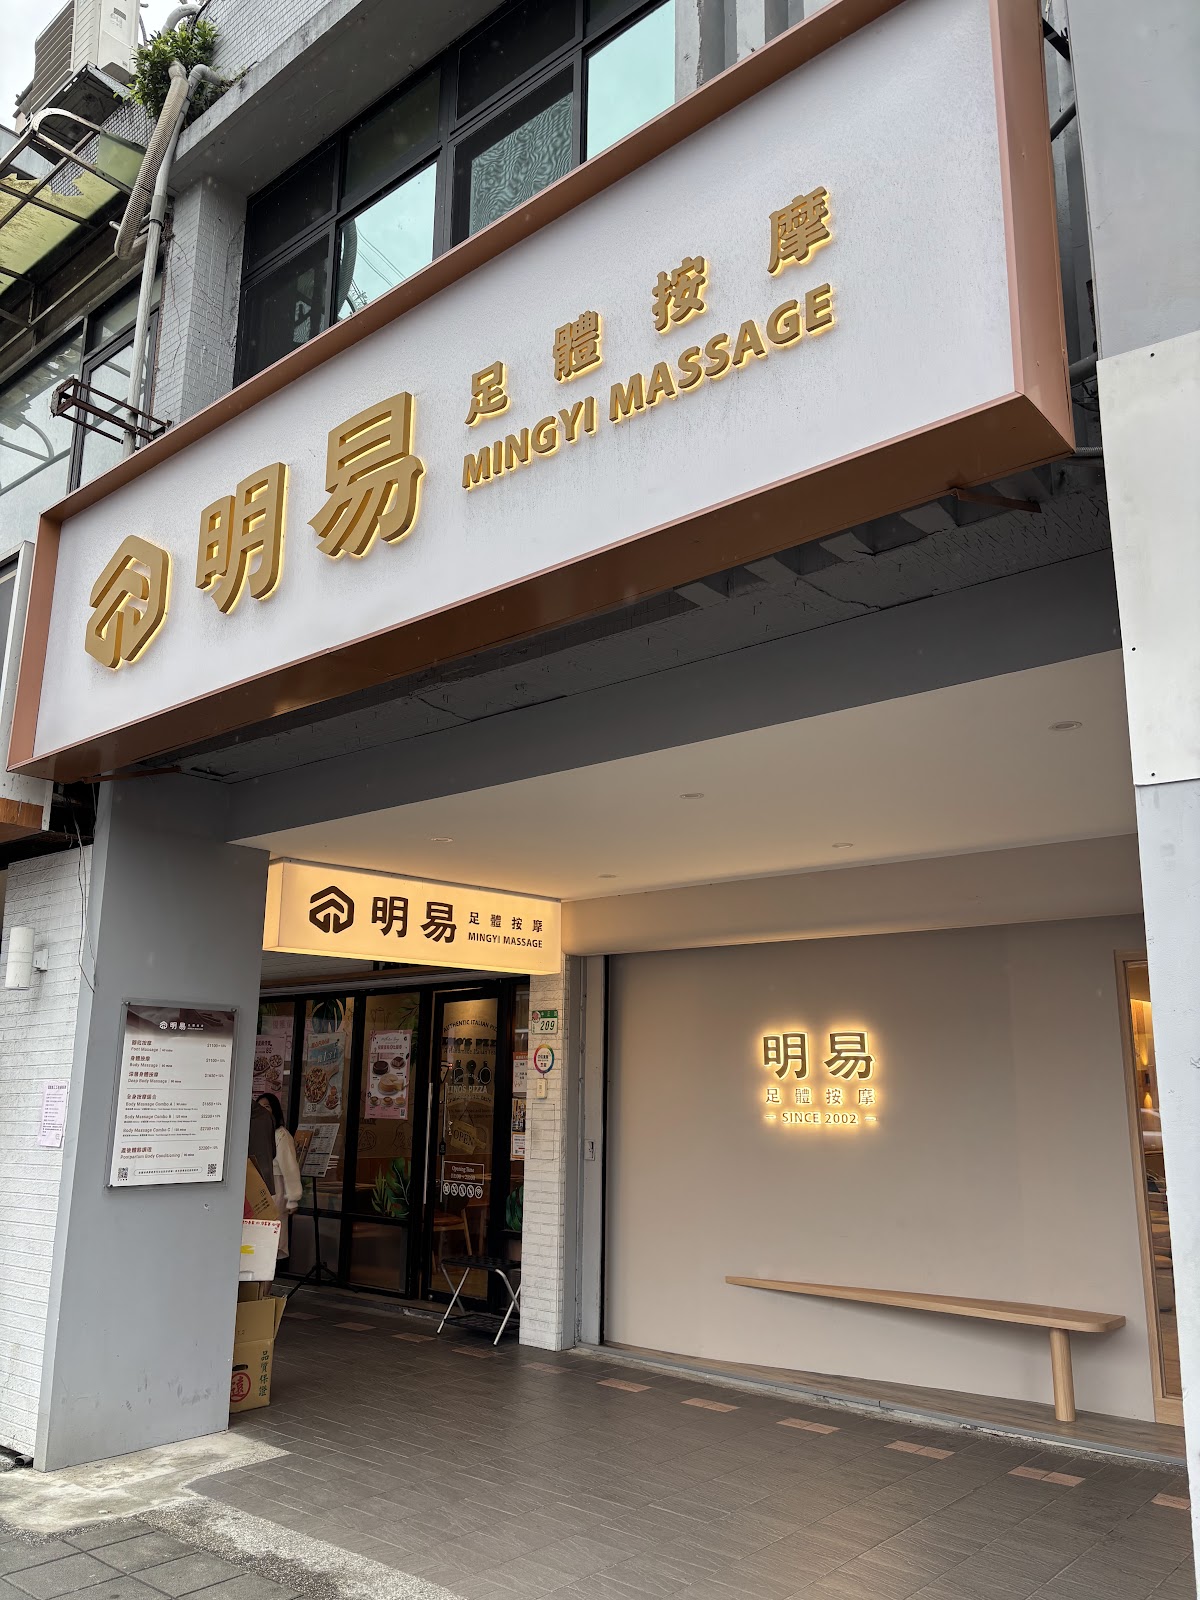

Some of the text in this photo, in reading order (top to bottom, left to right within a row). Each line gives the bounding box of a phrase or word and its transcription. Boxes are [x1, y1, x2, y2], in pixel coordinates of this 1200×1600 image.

[464, 186, 832, 426] 足體按摩
[462, 282, 835, 490] MINGYI MASSAGE
[195, 391, 426, 614] 明易
[371, 896, 458, 944] 明易
[468, 911, 544, 933] 足體按摩
[468, 931, 543, 948] MINGYI MASSAGE
[540, 1020, 555, 1030] 209
[763, 1032, 875, 1080] 明易
[468, 1085, 488, 1093] PIZZA
[765, 1088, 874, 1105] 足體按摩
[782, 1112, 858, 1124] SINCE 2002
[454, 1130, 475, 1146] OPEN
[258, 1350, 270, 1396] 品質保證
